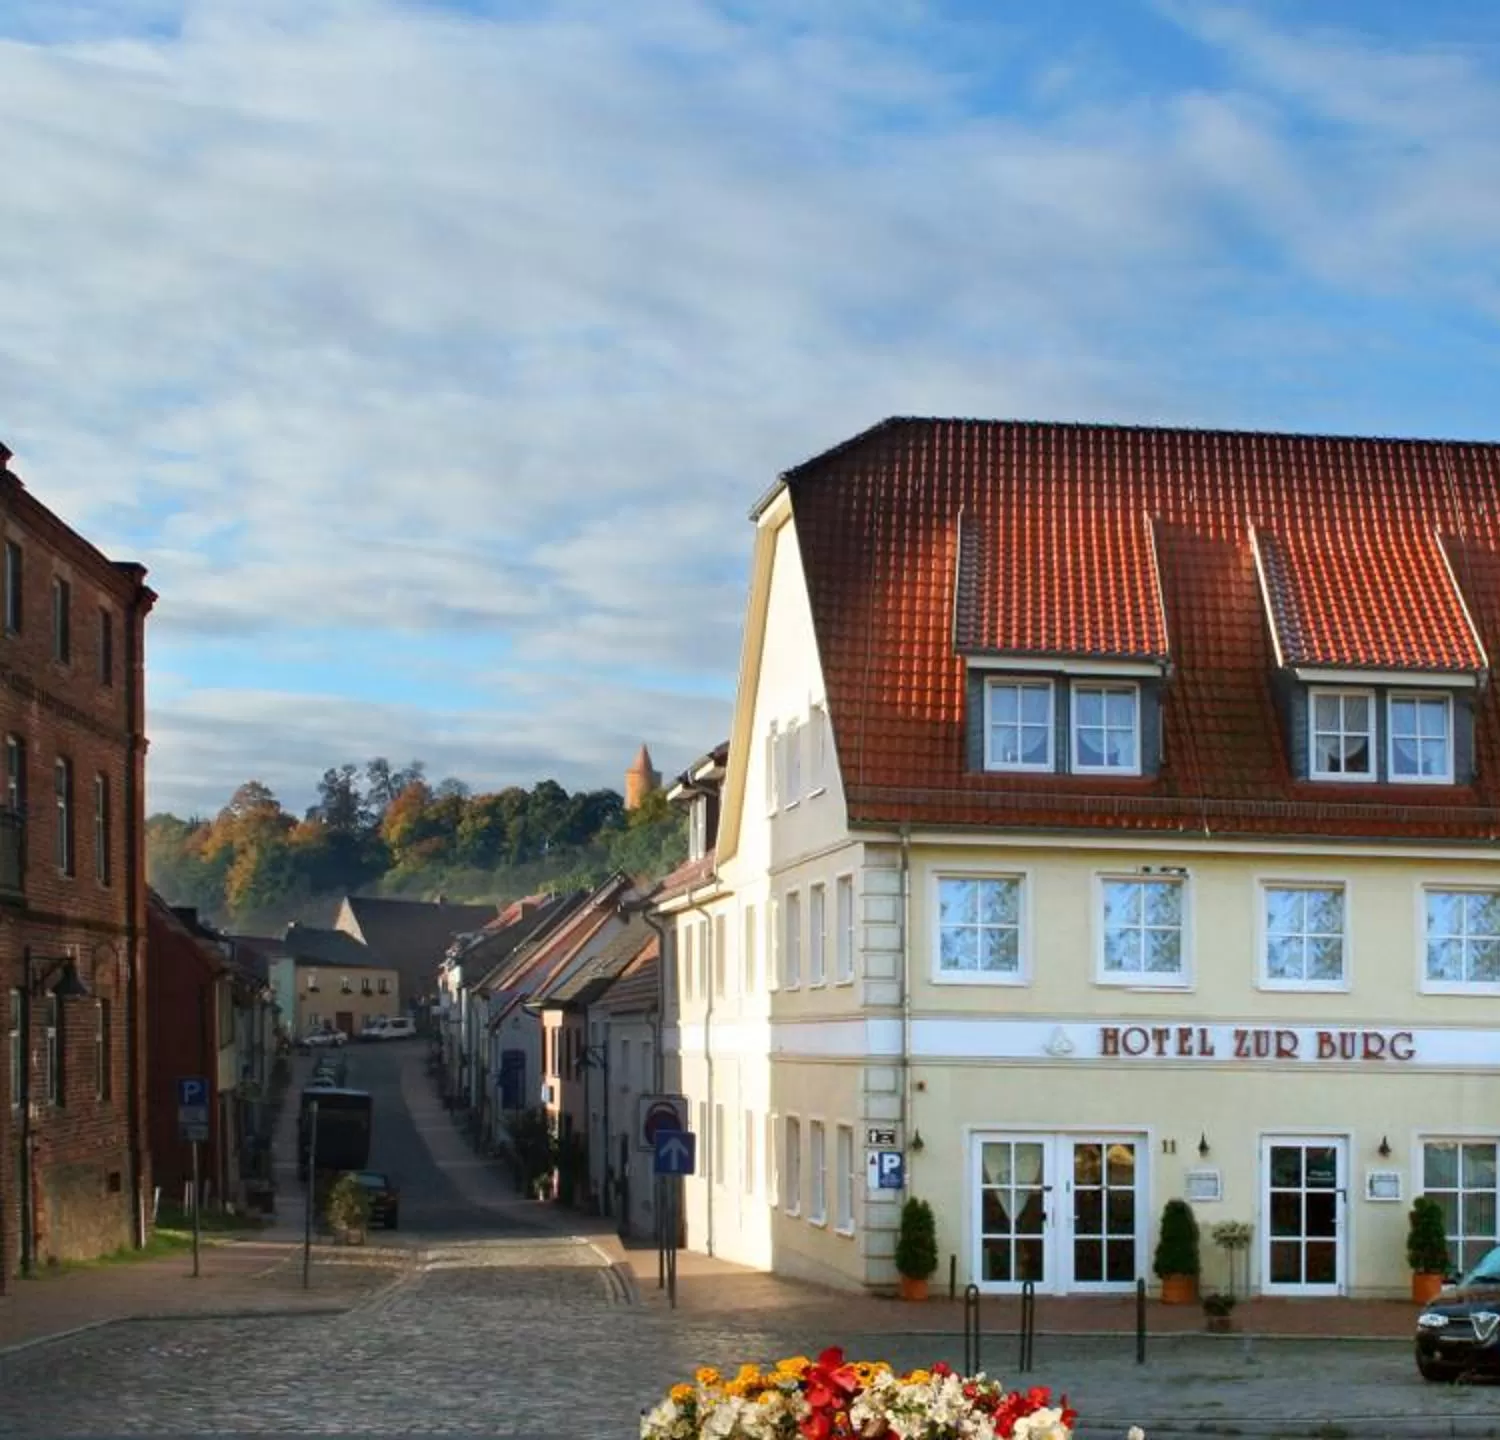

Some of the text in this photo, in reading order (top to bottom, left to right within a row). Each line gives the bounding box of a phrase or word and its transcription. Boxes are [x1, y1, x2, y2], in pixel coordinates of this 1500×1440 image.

[1100, 1026, 1417, 1061] HOTEL ZUR BURG
[184, 1081, 202, 1104] P
[1161, 1138, 1177, 1155] 11
[882, 1153, 901, 1174] P
